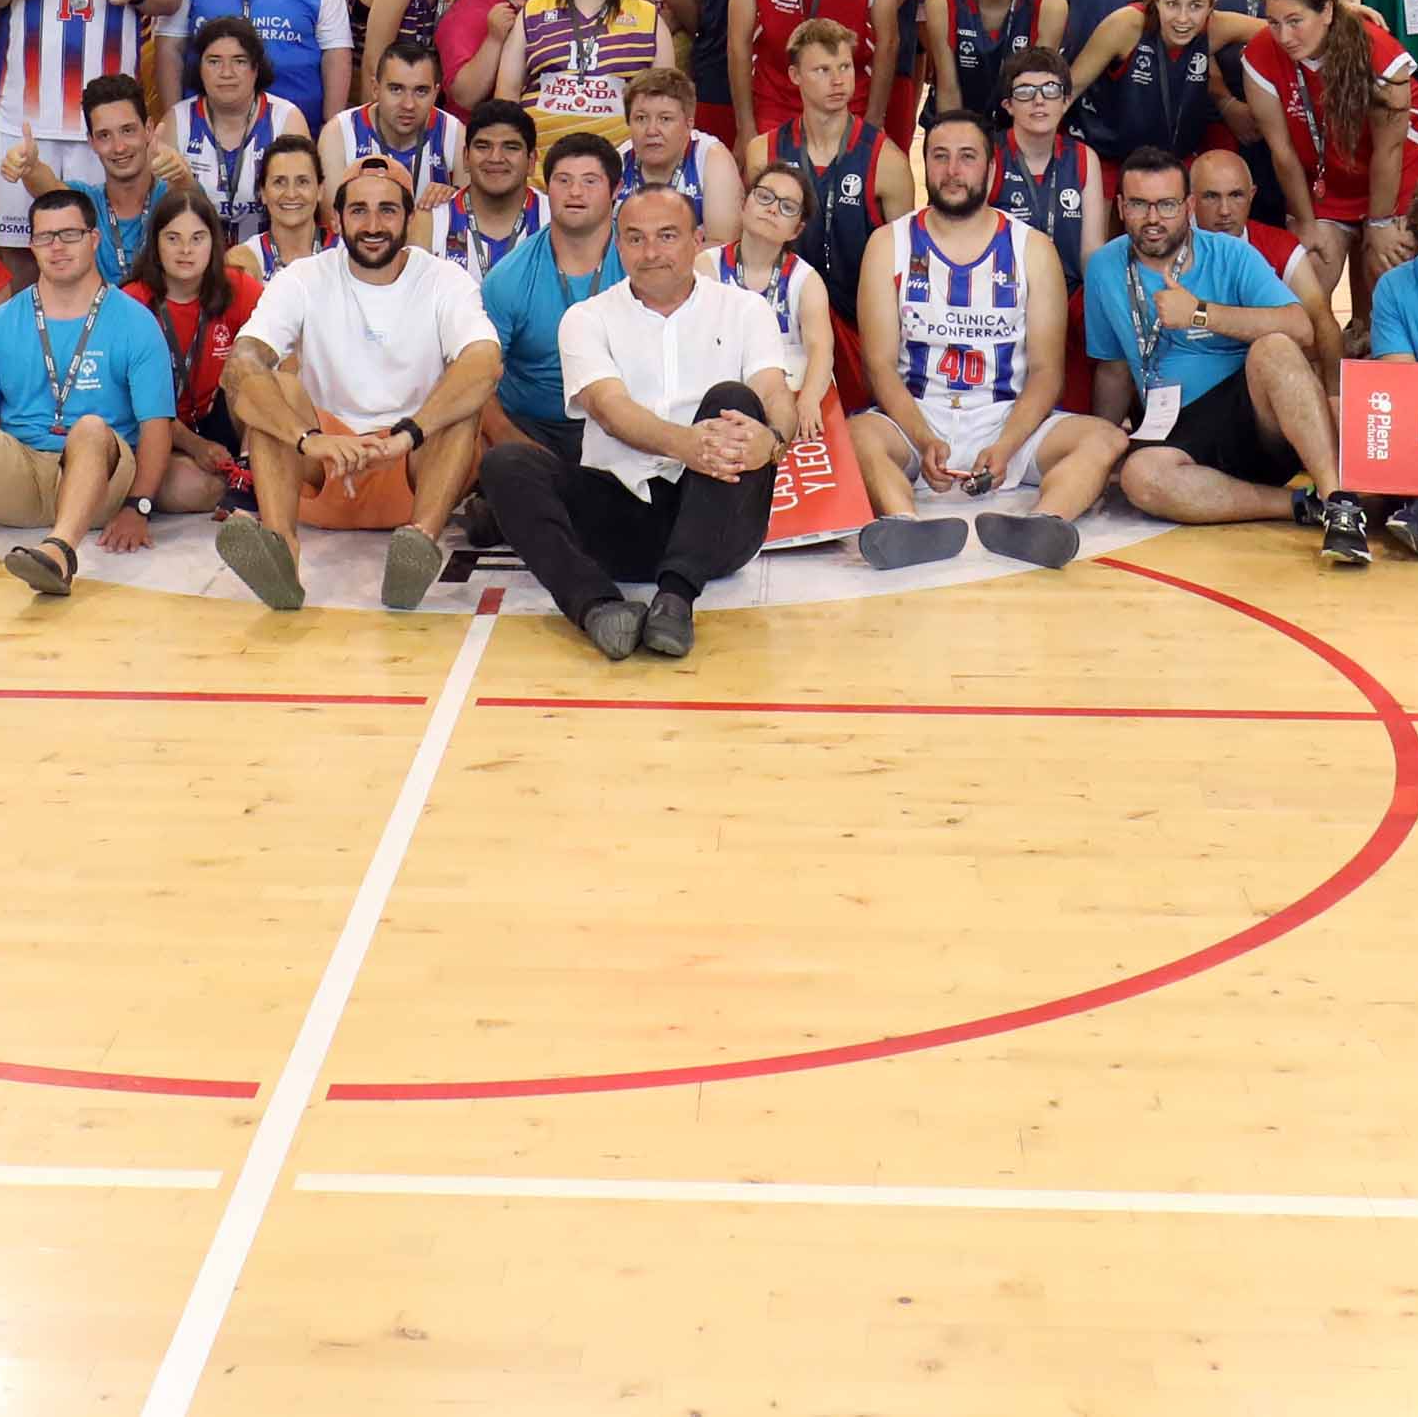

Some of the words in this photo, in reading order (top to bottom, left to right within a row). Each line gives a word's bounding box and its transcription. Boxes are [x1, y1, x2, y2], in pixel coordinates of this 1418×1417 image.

[544, 85, 617, 100] ARANDA
[928, 324, 1017, 338] PONFERRADA
[937, 346, 986, 385] 40
[1367, 414, 1377, 459] inclusión
[1376, 414, 1392, 460] Plena
[802, 482, 836, 495] Y
